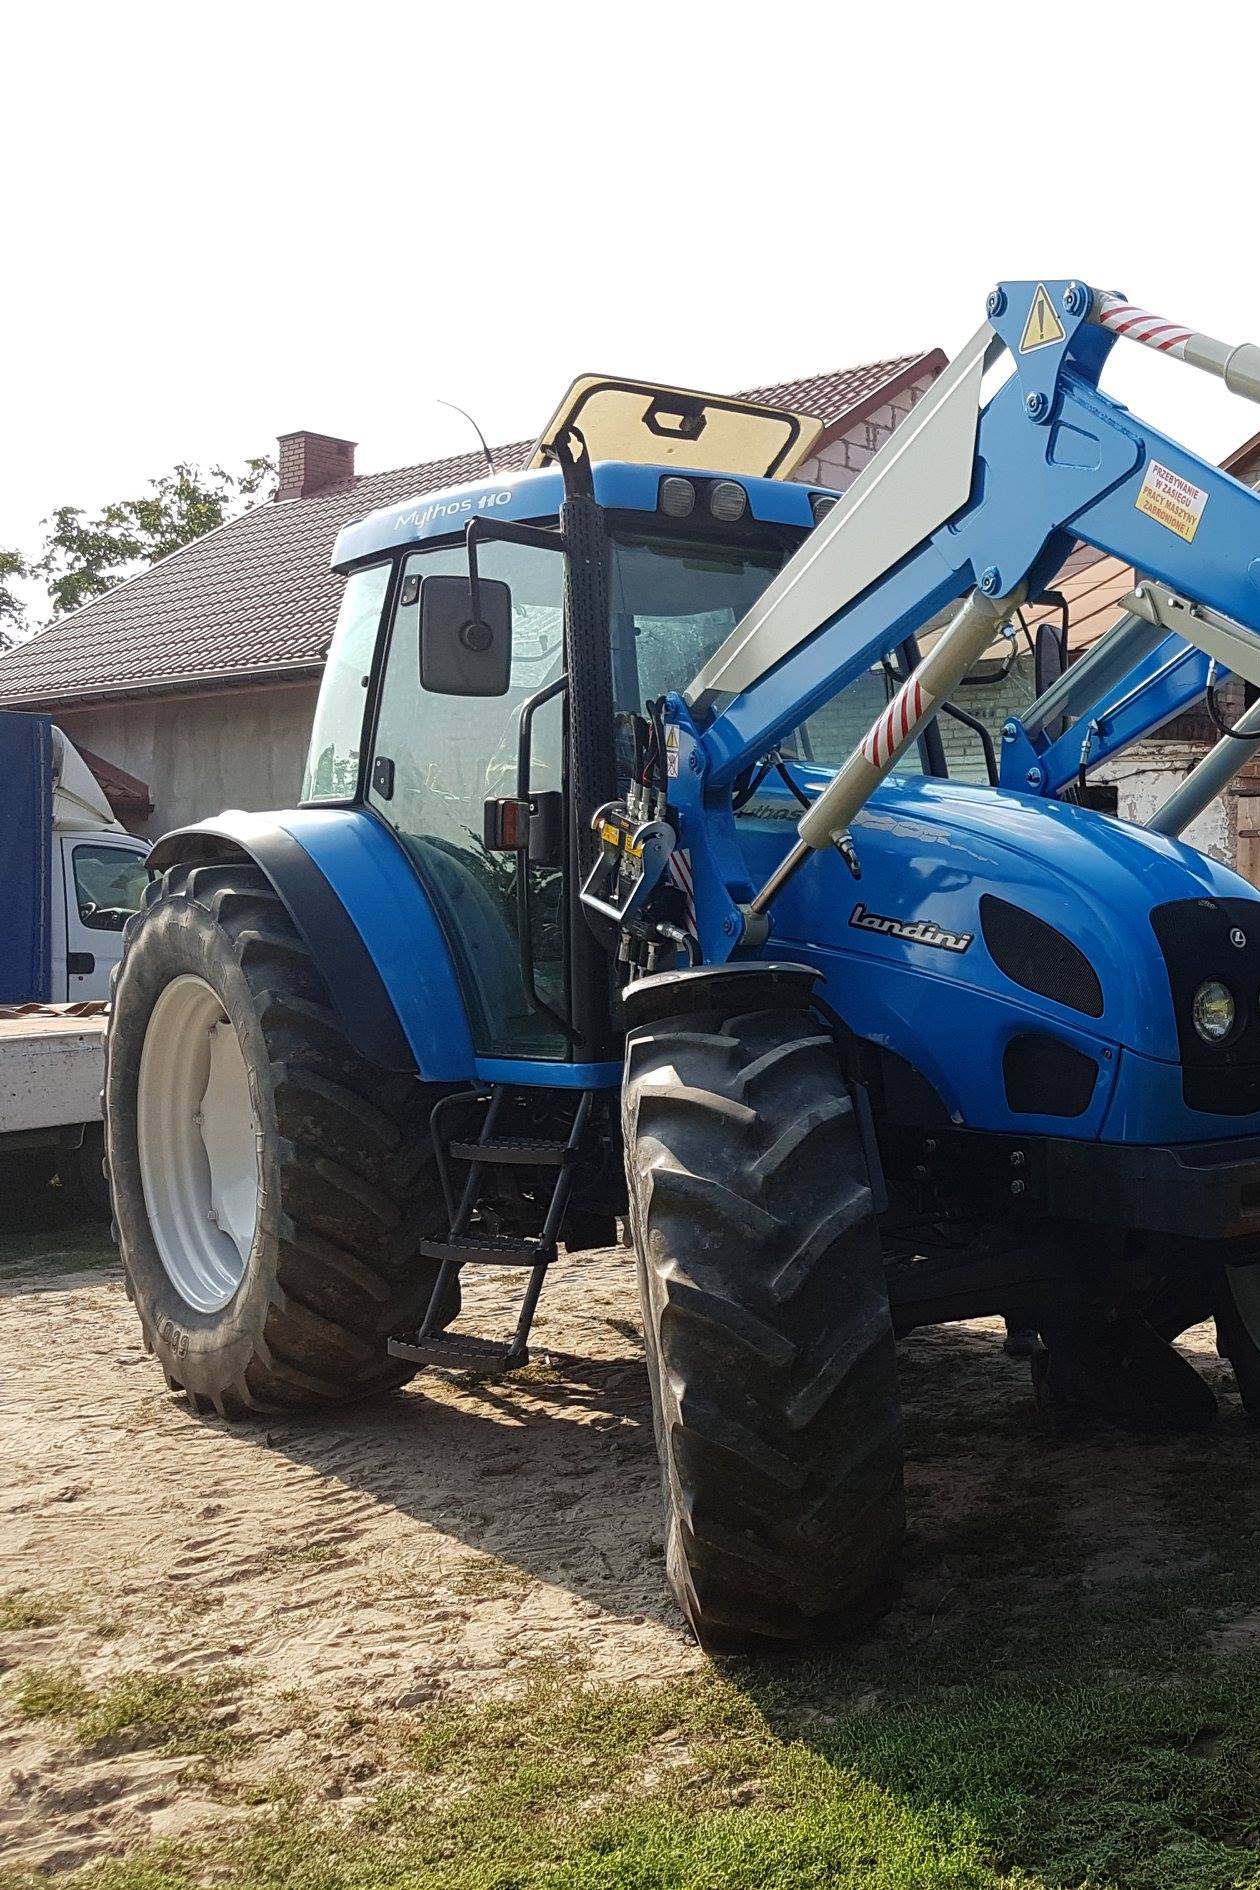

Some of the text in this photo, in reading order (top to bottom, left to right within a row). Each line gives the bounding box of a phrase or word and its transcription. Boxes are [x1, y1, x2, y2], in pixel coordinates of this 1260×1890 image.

[1153, 465, 1199, 499] PRZEBYWANIE
[1156, 479, 1191, 507] W ZASIĘGU
[394, 491, 512, 530] Mythos 110
[1143, 486, 1197, 525] PRACY MASZYNY
[1143, 500, 1186, 533] ZABRONIONE
[851, 906, 971, 950] Landini
